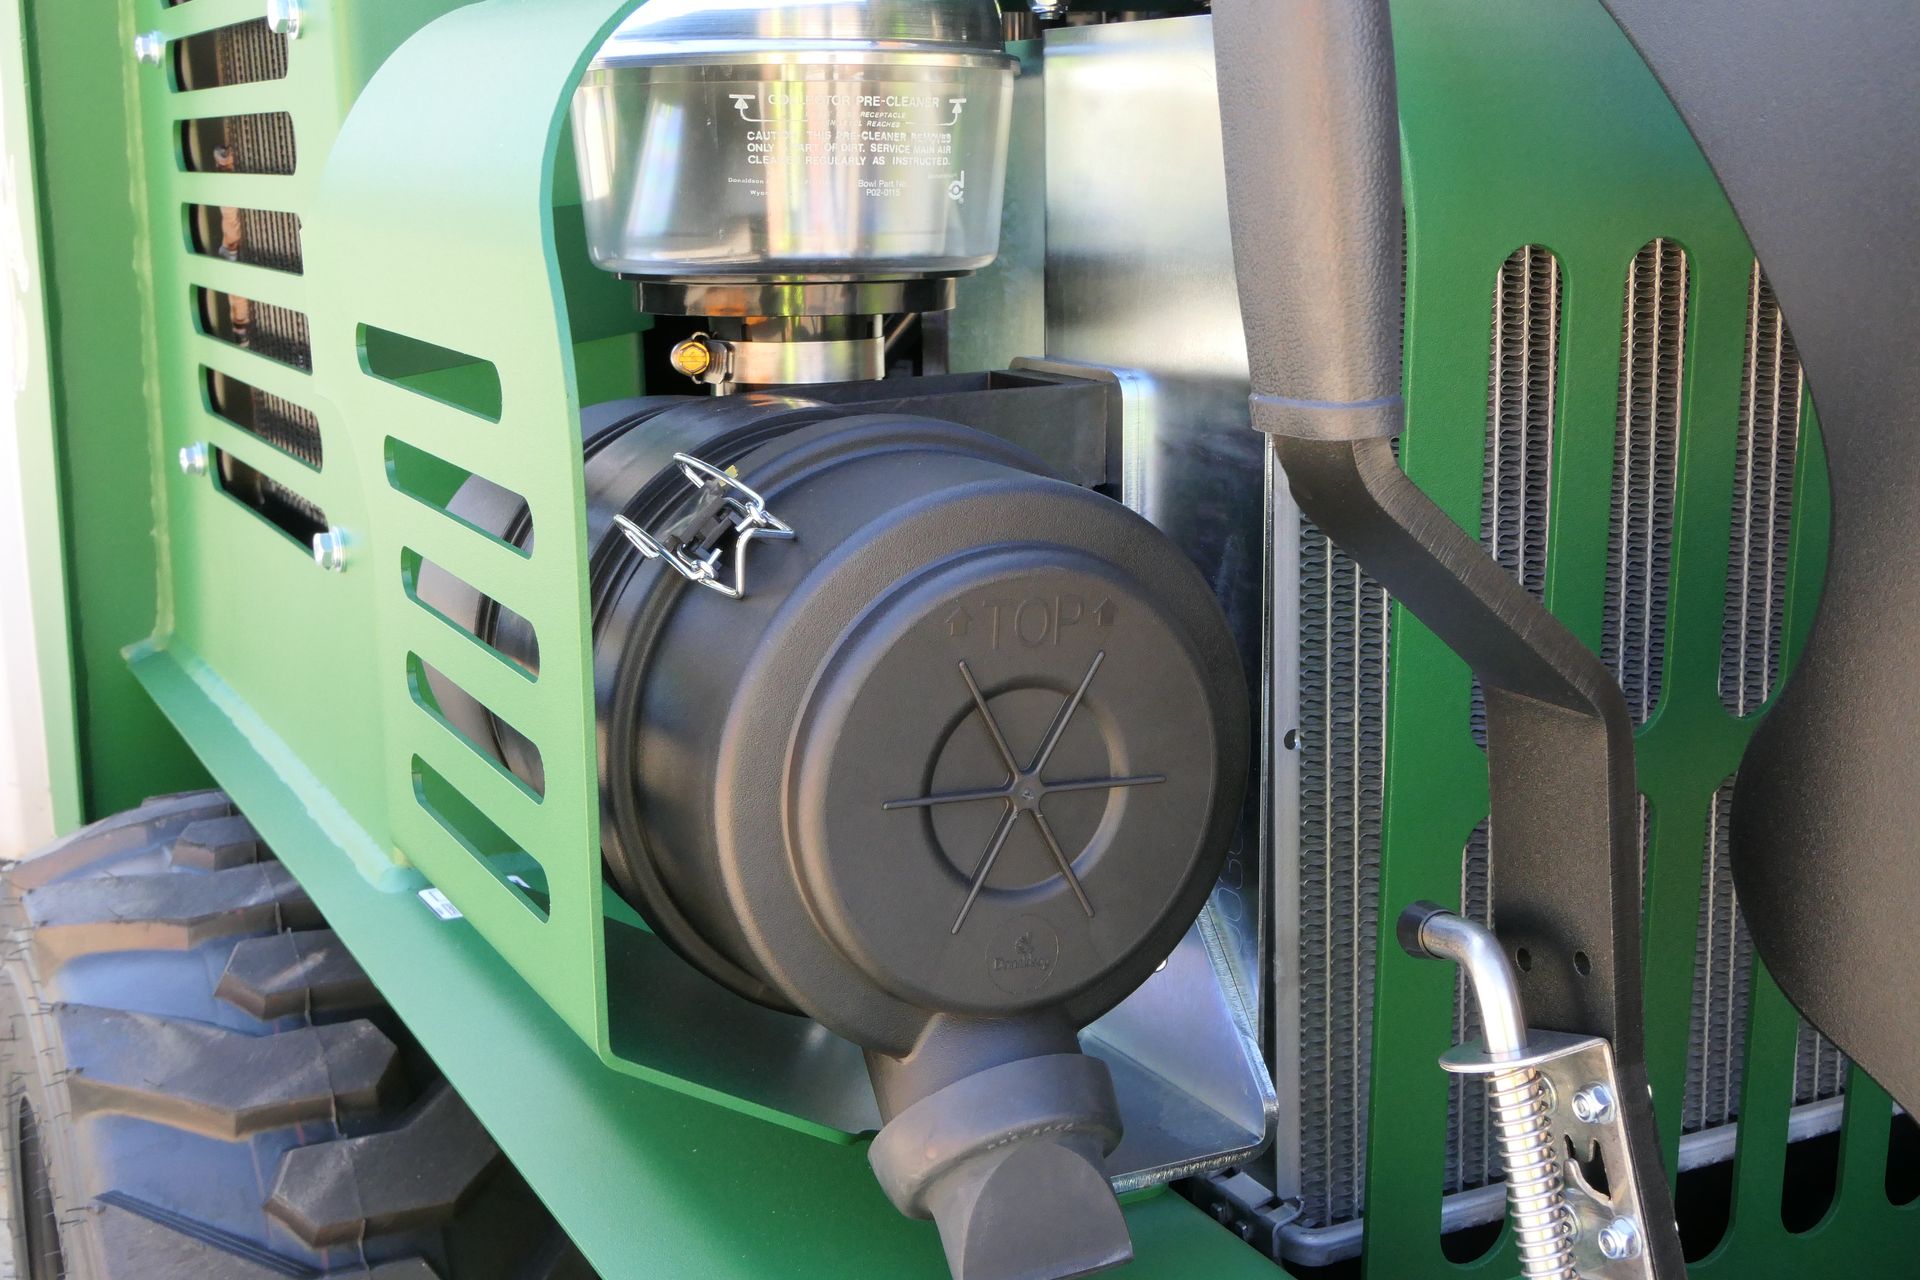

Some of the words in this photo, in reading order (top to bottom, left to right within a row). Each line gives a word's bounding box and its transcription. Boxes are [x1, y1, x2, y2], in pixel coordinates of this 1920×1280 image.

[857, 95, 940, 108] PRE-CLEANER
[860, 111, 907, 119] RECEPTACLE
[866, 120, 901, 128] REACHES
[747, 143, 774, 152] ONLY
[823, 143, 838, 153] OF
[841, 143, 866, 154] DIRT.
[870, 144, 910, 154] SERVICE
[937, 145, 952, 154] AIR
[805, 156, 867, 166] REGULARLY
[872, 157, 886, 166] AS
[892, 156, 951, 166] INSTRUCTED.
[728, 177, 765, 185] Donaldson
[858, 180, 877, 188] Bowl
[879, 180, 894, 188] Part
[866, 188, 901, 197] P02-0115
[982, 593, 1084, 650] TOP
